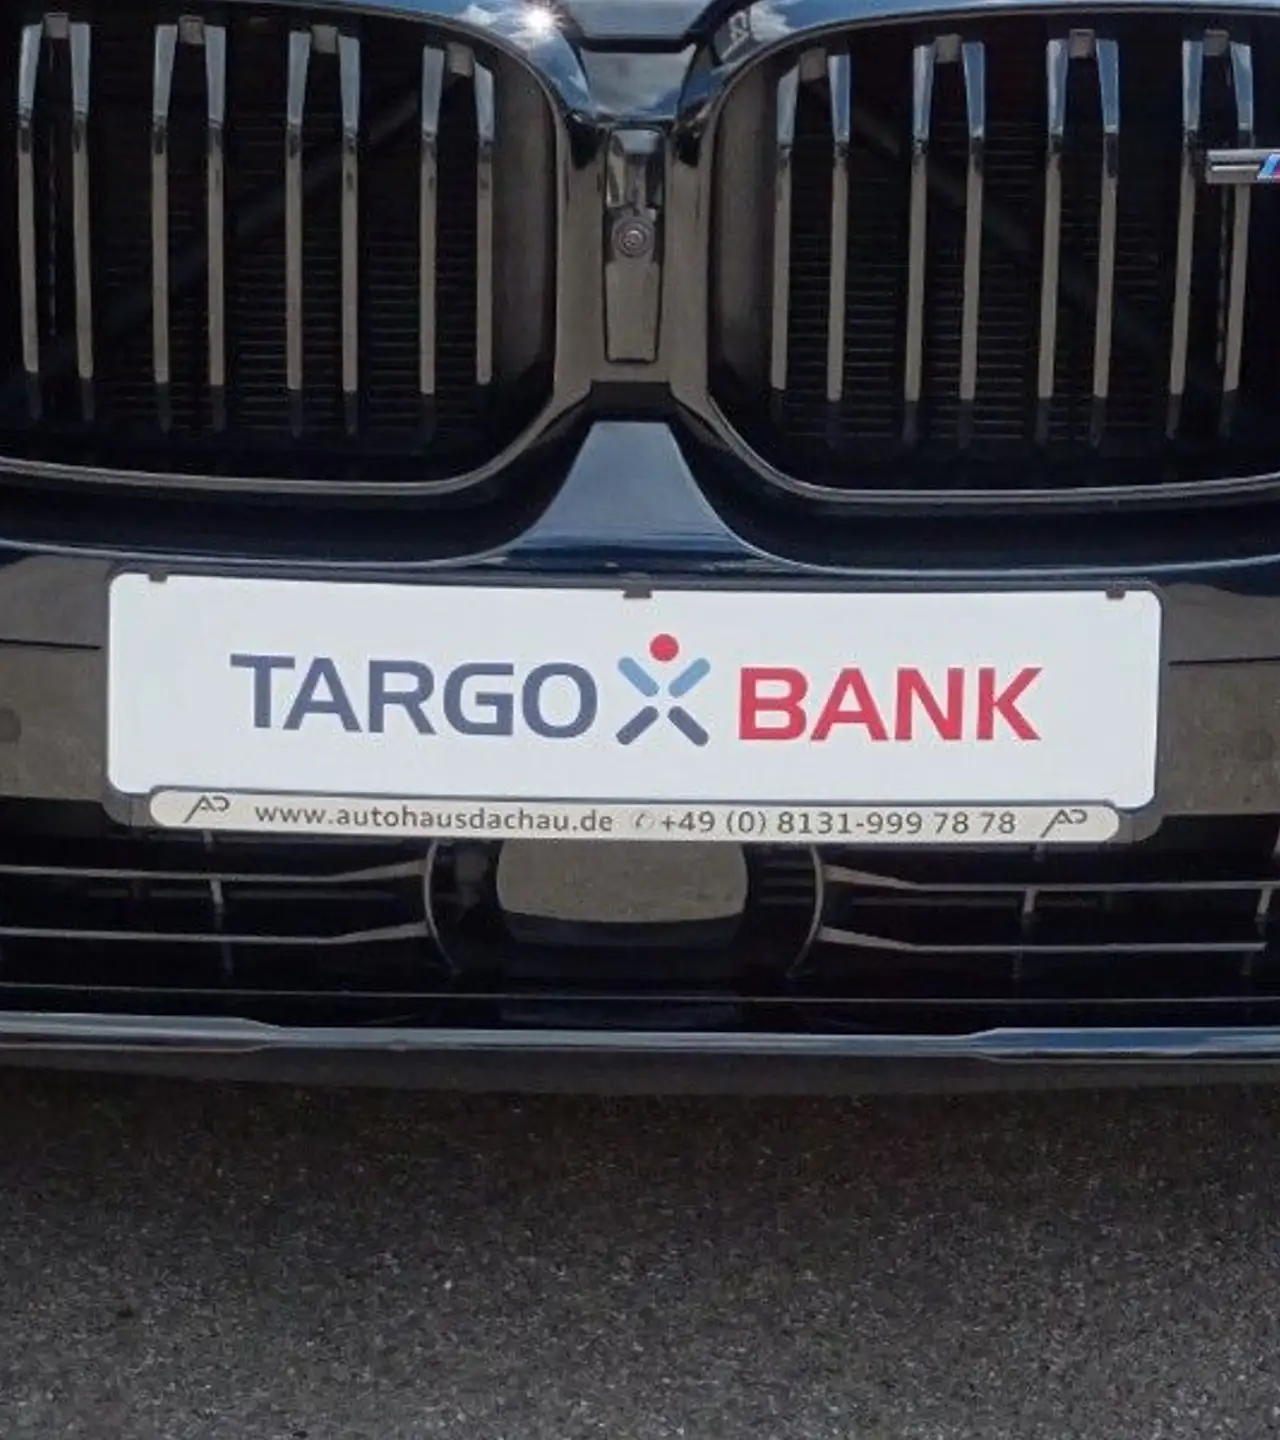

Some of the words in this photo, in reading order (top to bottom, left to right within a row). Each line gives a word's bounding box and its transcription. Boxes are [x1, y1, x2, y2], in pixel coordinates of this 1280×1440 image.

[229, 653, 599, 739] TARGO
[737, 666, 1044, 742] BANK
[254, 803, 615, 832] www.autohausdachau.de
[661, 811, 716, 834] +49
[725, 810, 768, 836] (0)
[776, 811, 923, 835] 8131-999
[933, 812, 970, 835] 78
[980, 812, 1018, 835] 78
